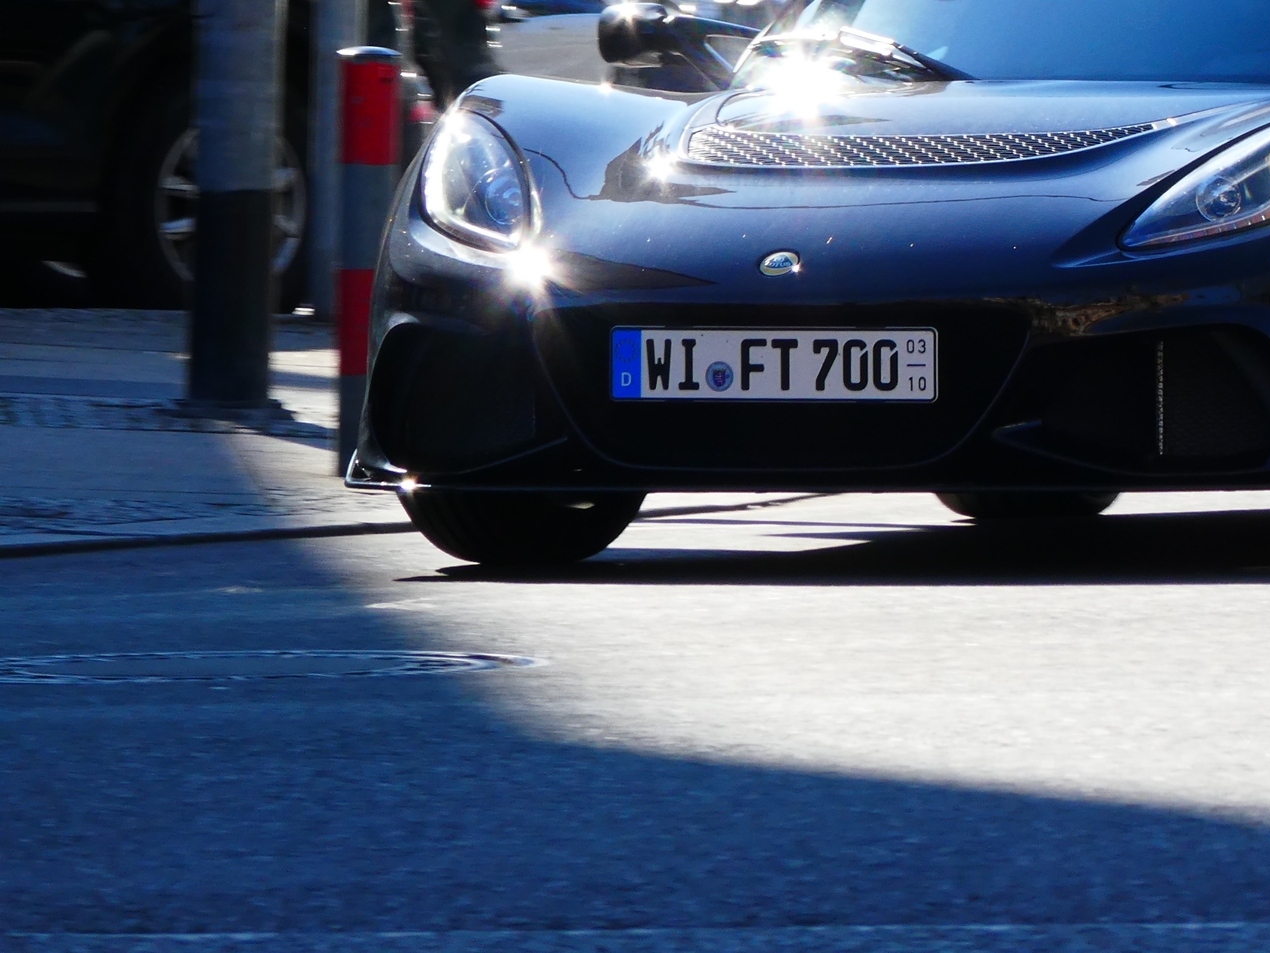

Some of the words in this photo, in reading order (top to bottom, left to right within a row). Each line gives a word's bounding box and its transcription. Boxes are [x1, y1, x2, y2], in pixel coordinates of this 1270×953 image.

[906, 339, 926, 354] 03
[646, 338, 700, 391] WI
[740, 338, 798, 391] FT
[812, 338, 899, 392] 700
[621, 371, 631, 387] D
[908, 376, 926, 392] 10
